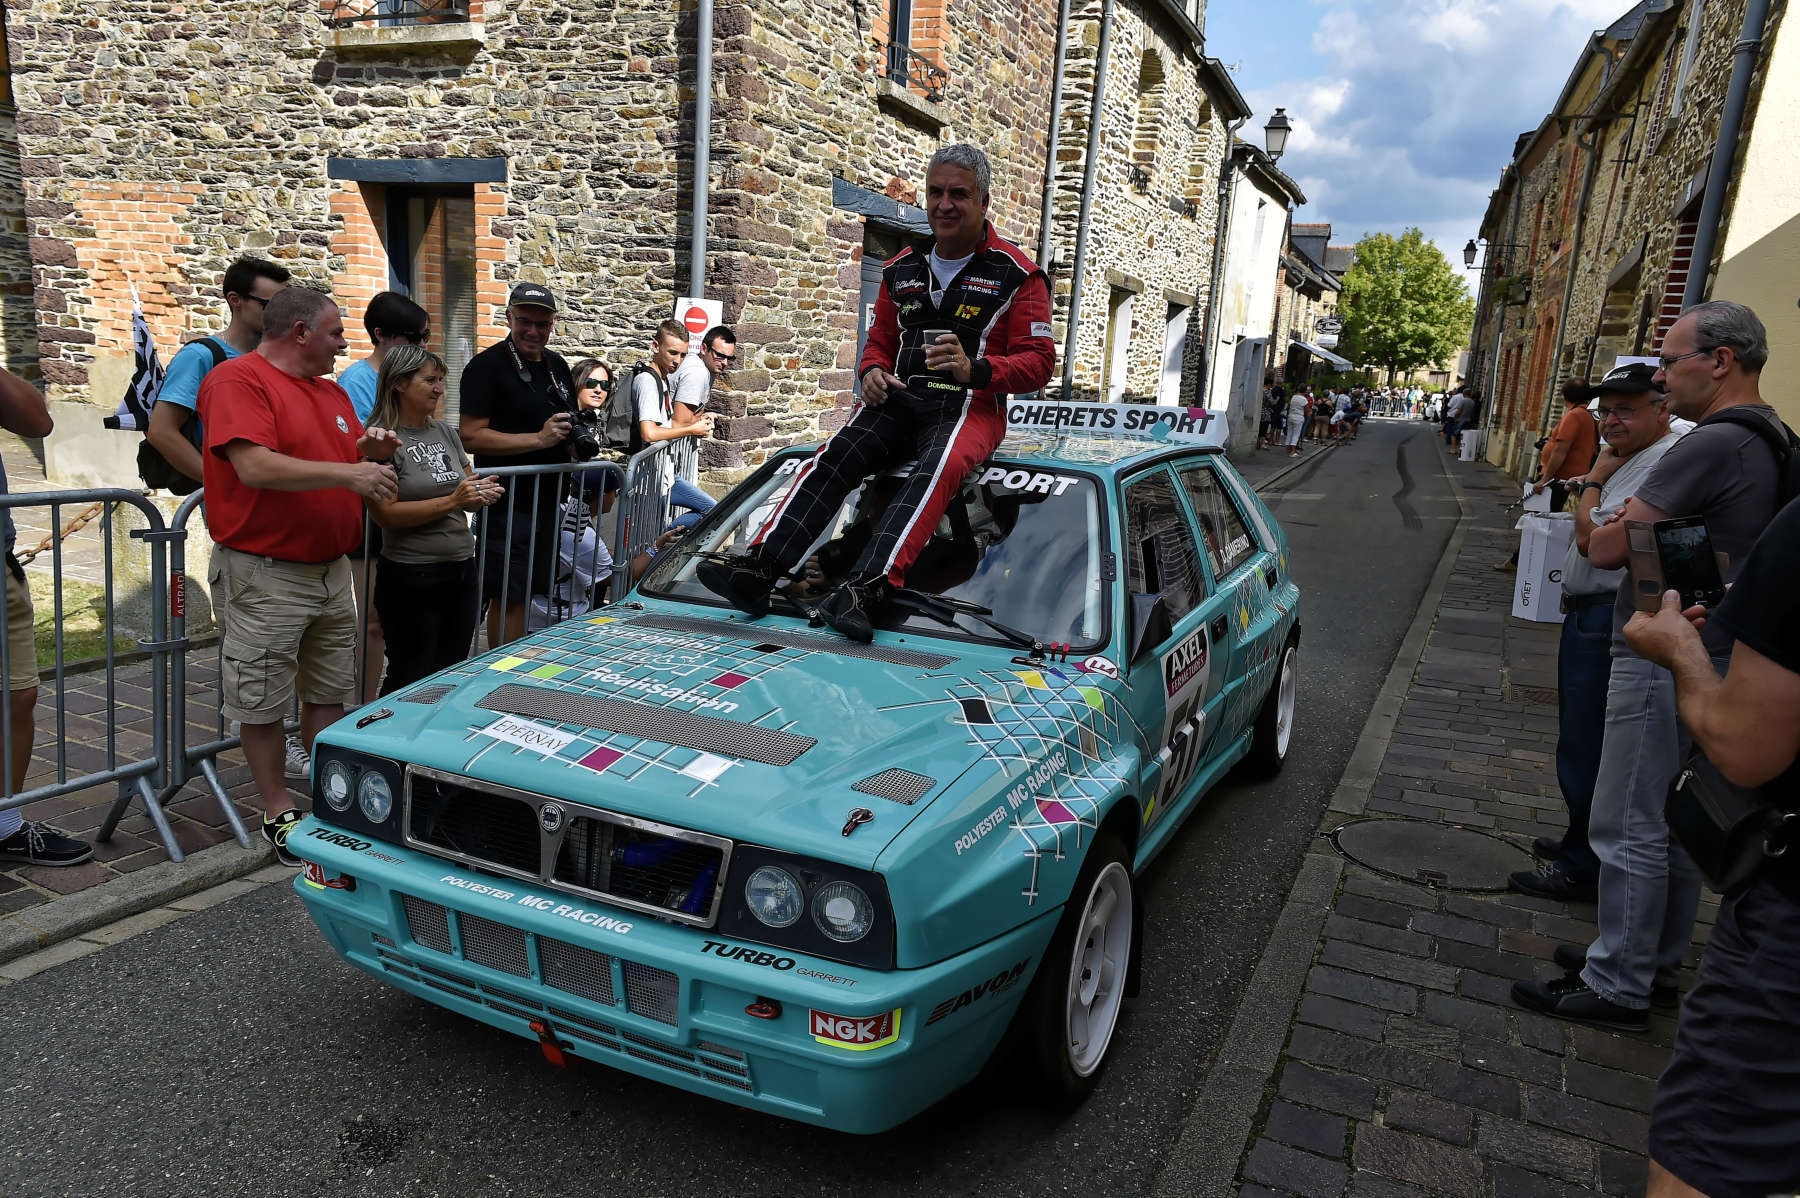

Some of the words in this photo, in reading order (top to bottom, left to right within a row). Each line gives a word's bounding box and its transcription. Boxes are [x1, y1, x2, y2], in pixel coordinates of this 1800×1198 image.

[967, 285, 992, 294] RACING
[970, 276, 995, 286] MARTINI
[1007, 405, 1118, 429] CHERETS
[1123, 409, 1215, 435] SPORT
[1170, 655, 1205, 692] FERMETURES
[1171, 633, 1203, 679] AXEL
[591, 666, 739, 714] Réalisation
[492, 720, 568, 750] EPERNAY
[954, 805, 1008, 856] POLYESTER
[1006, 783, 1029, 810] MC
[1025, 751, 1066, 793] RACING
[306, 827, 372, 851] TURBO
[364, 850, 405, 865] GARRETT
[440, 875, 516, 901] POLYESTER
[517, 895, 554, 911] MC
[551, 904, 634, 935] RACING
[701, 940, 796, 971] TURBO
[796, 967, 858, 987] GARRETT
[816, 1014, 876, 1041] NGK
